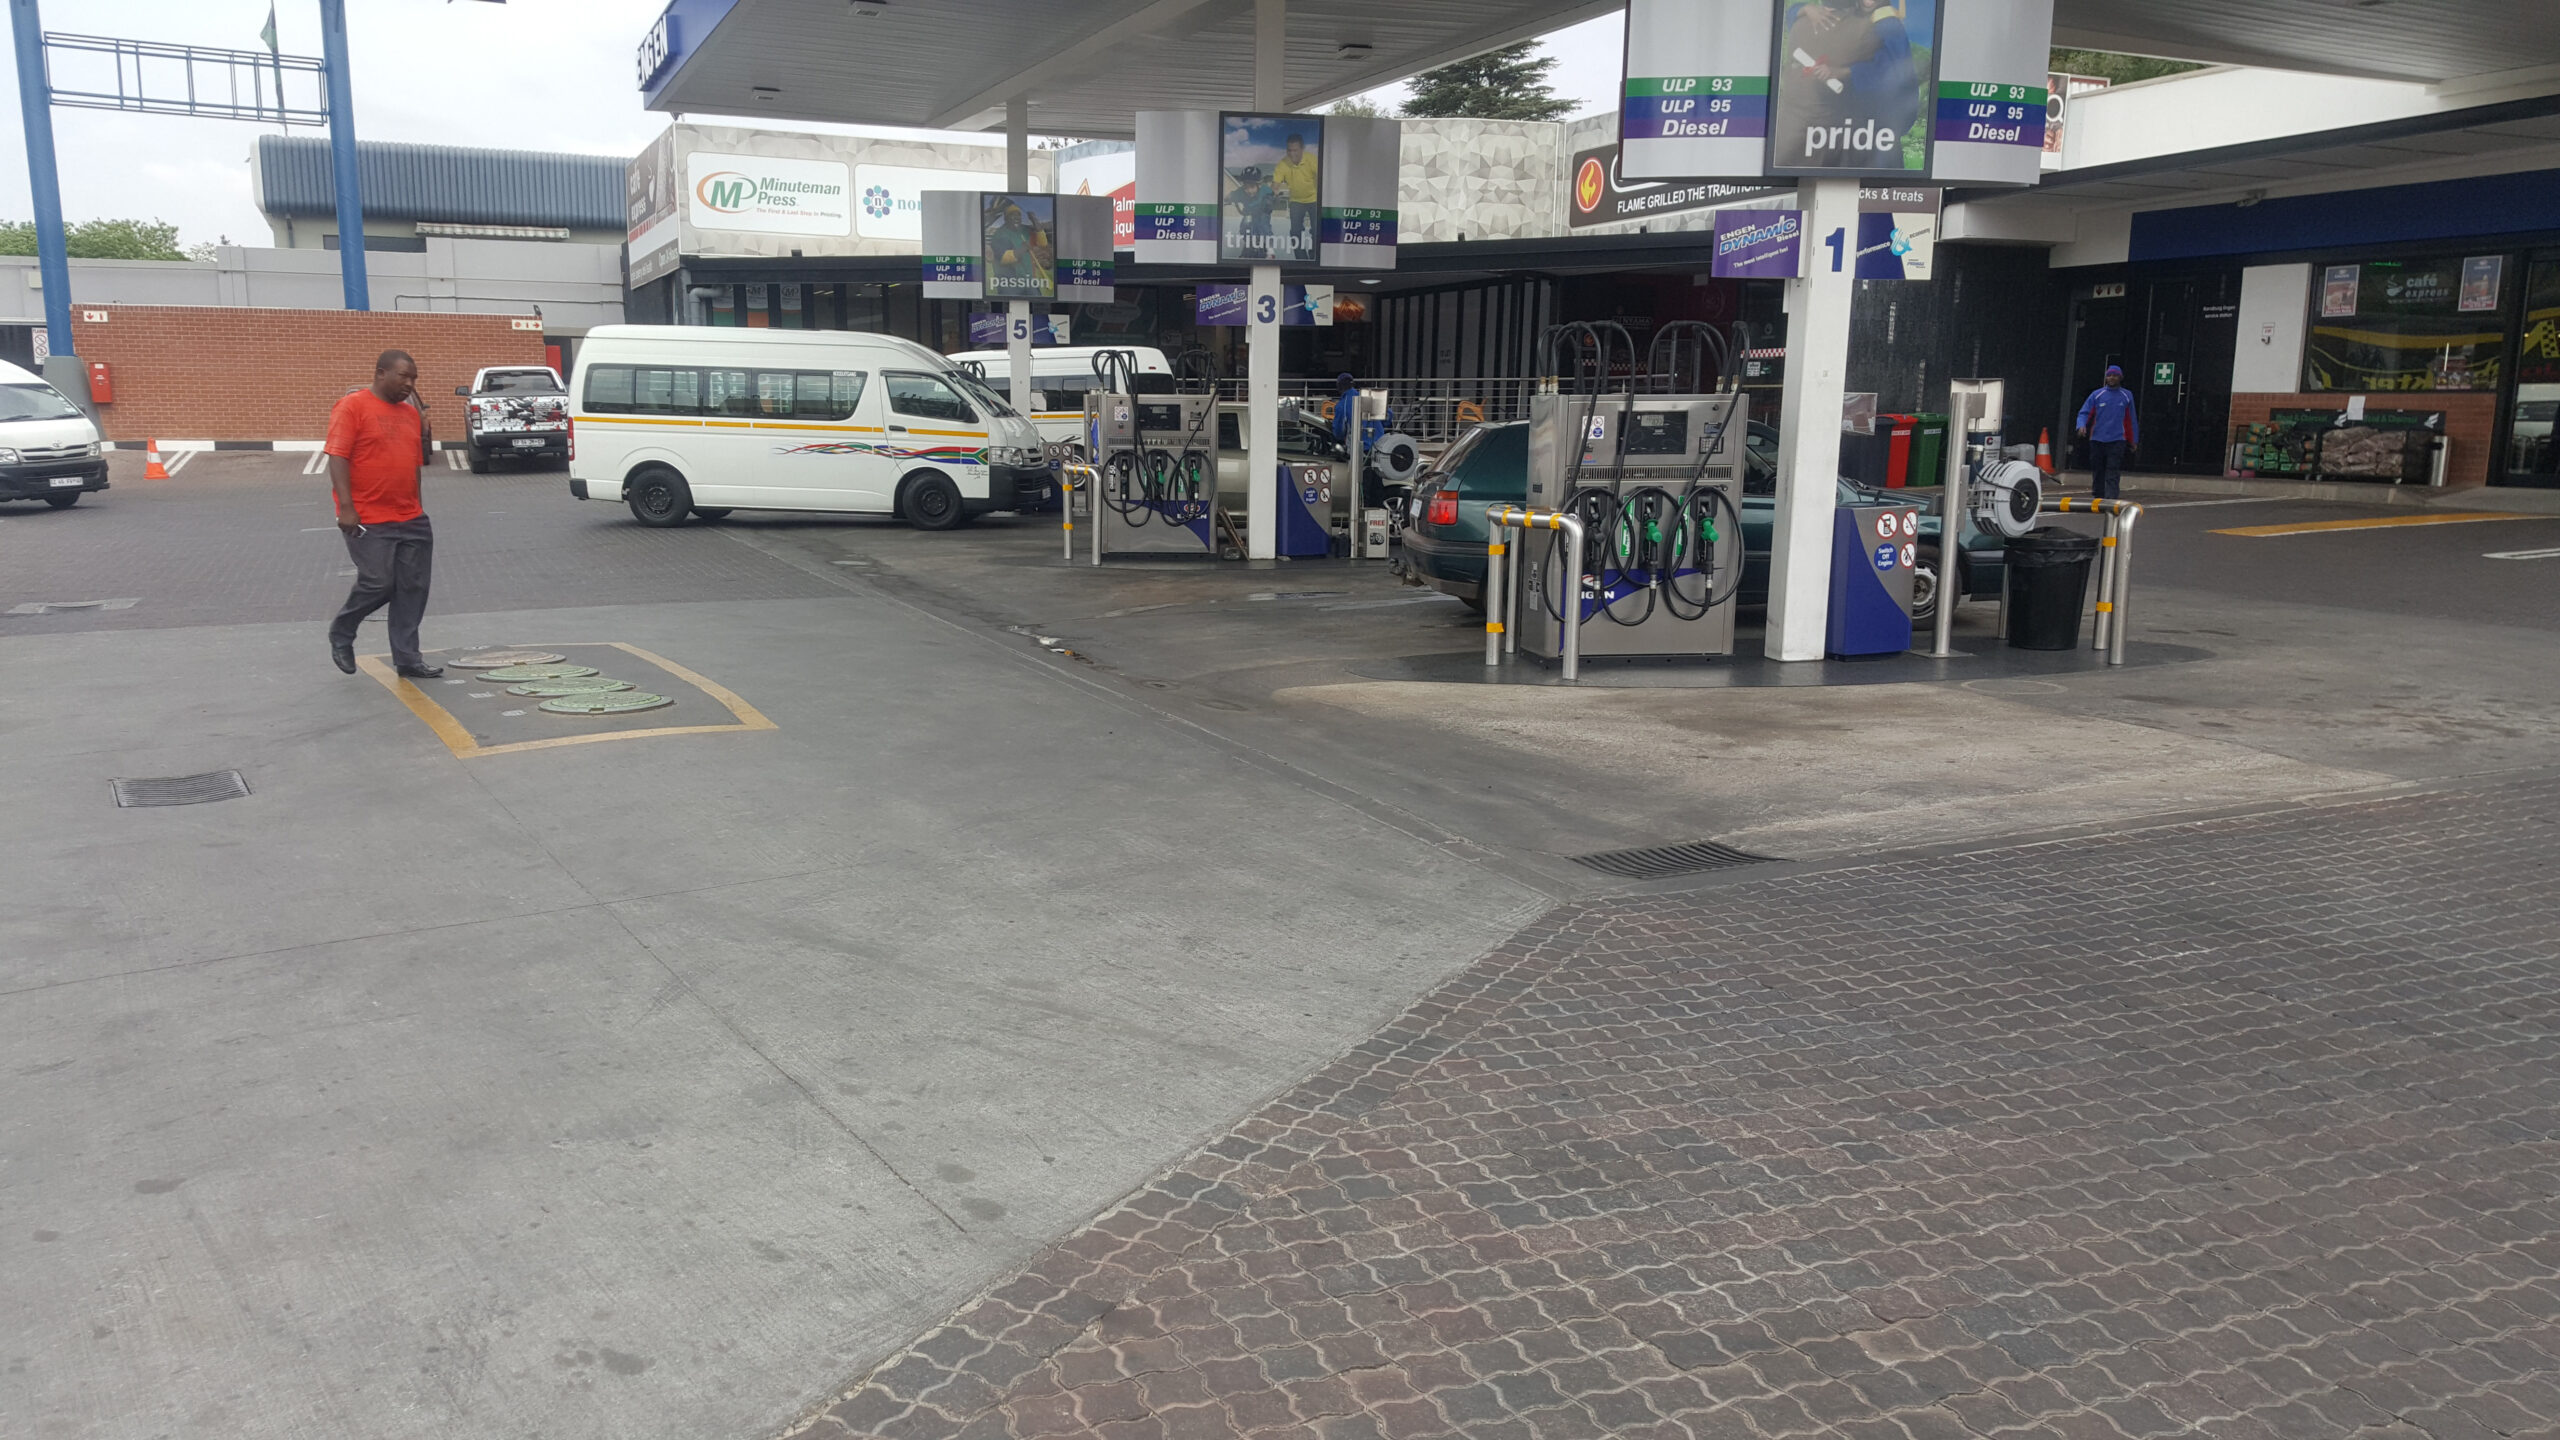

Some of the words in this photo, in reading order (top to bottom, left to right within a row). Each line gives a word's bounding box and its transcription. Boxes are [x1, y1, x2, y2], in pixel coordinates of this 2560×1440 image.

[1662, 78, 1696, 92] ULP
[1711, 78, 1733, 92] 93
[1970, 83, 1998, 97] ULP
[2009, 86, 2025, 99] 93
[1661, 99, 1695, 113] ULP
[1710, 99, 1732, 113] 95
[1968, 103, 1997, 117] ULP
[2007, 106, 2024, 120] 95
[1662, 118, 1728, 136] Diesel
[1968, 122, 2021, 142] Diesel
[1804, 118, 1895, 157] pride
[759, 177, 841, 195] Minuteman
[757, 191, 797, 207] Press
[1617, 197, 1646, 214] FLAME
[1647, 190, 1686, 208] GRILLED
[1688, 186, 1705, 201] THE
[1881, 188, 1889, 200] &
[1892, 190, 1924, 202] treats
[1155, 205, 1175, 214] ULP
[1183, 205, 1196, 214] 93
[1343, 208, 1362, 218] ULP
[1369, 210, 1381, 218] 93
[1155, 217, 1175, 226] ULP
[1183, 217, 1196, 226] 95
[1343, 221, 1361, 230] ULP
[1369, 222, 1380, 231] 95
[1156, 229, 1194, 240] Diesel
[1343, 233, 1379, 244] Diesel
[1719, 215, 1796, 256] DYNAMIC
[1720, 224, 1756, 241] ENGEN
[1224, 230, 1313, 253] triumph
[1825, 227, 1845, 272] 1
[1072, 259, 1086, 267] ULP
[937, 273, 965, 281] Diesel
[1072, 268, 1086, 276] ULP
[989, 274, 1050, 290] passion
[1073, 277, 1100, 286] Diesel
[2406, 274, 2437, 287] café
[2405, 288, 2449, 298] express
[1257, 295, 1276, 323] 3
[1013, 319, 1027, 340] 5
[1877, 560, 1893, 568] Engine
